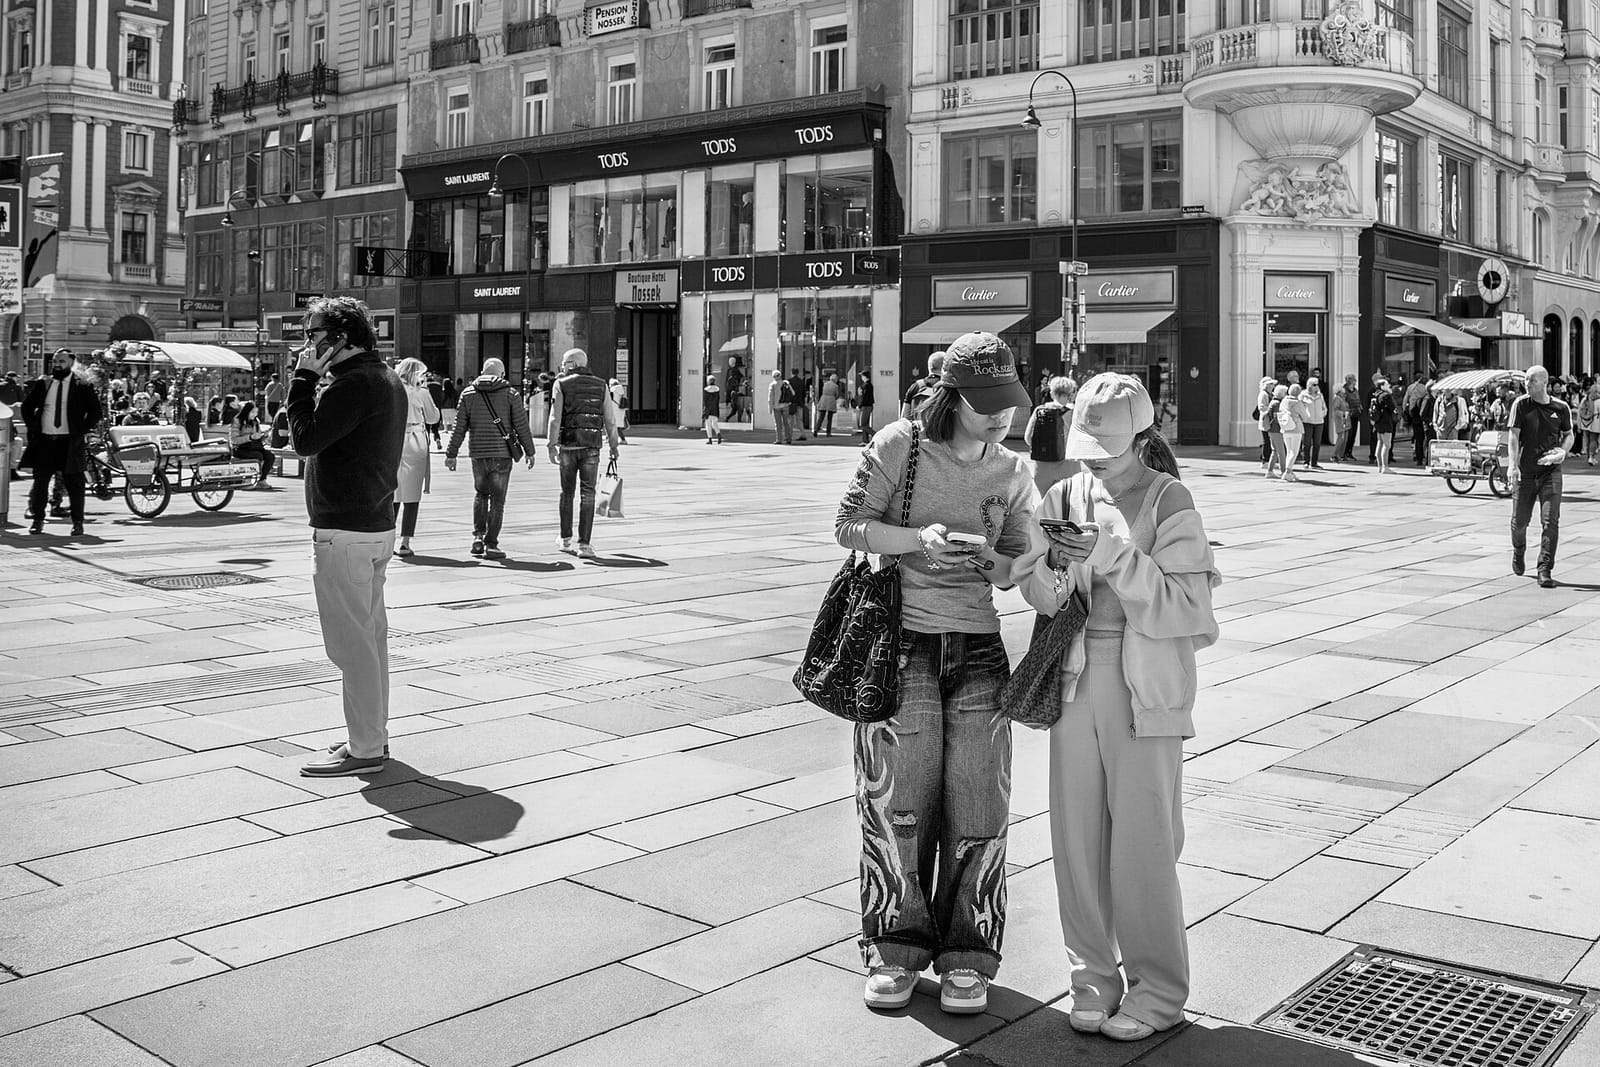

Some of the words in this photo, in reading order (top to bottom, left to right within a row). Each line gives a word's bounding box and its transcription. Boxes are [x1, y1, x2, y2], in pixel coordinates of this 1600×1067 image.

[596, 5, 629, 20] PENSION
[598, 16, 626, 30] NOSSEK
[795, 125, 834, 145] TOD'S
[702, 137, 737, 156] TOD'S
[598, 151, 629, 169] TOD'S
[444, 176, 462, 186] SAINT
[462, 172, 490, 184] LAURENT
[806, 261, 843, 278] TOD'S
[864, 261, 879, 270] TOD'S
[627, 272, 651, 284] Boutique
[652, 271, 666, 283] Hotel
[712, 266, 745, 283] TOD'S
[474, 288, 492, 298] SAINT
[492, 286, 521, 297] LAURENT
[632, 284, 661, 302] Nossek
[961, 286, 998, 301] Cartier
[1098, 281, 1139, 297] Cartier
[1277, 285, 1316, 298] Cartier
